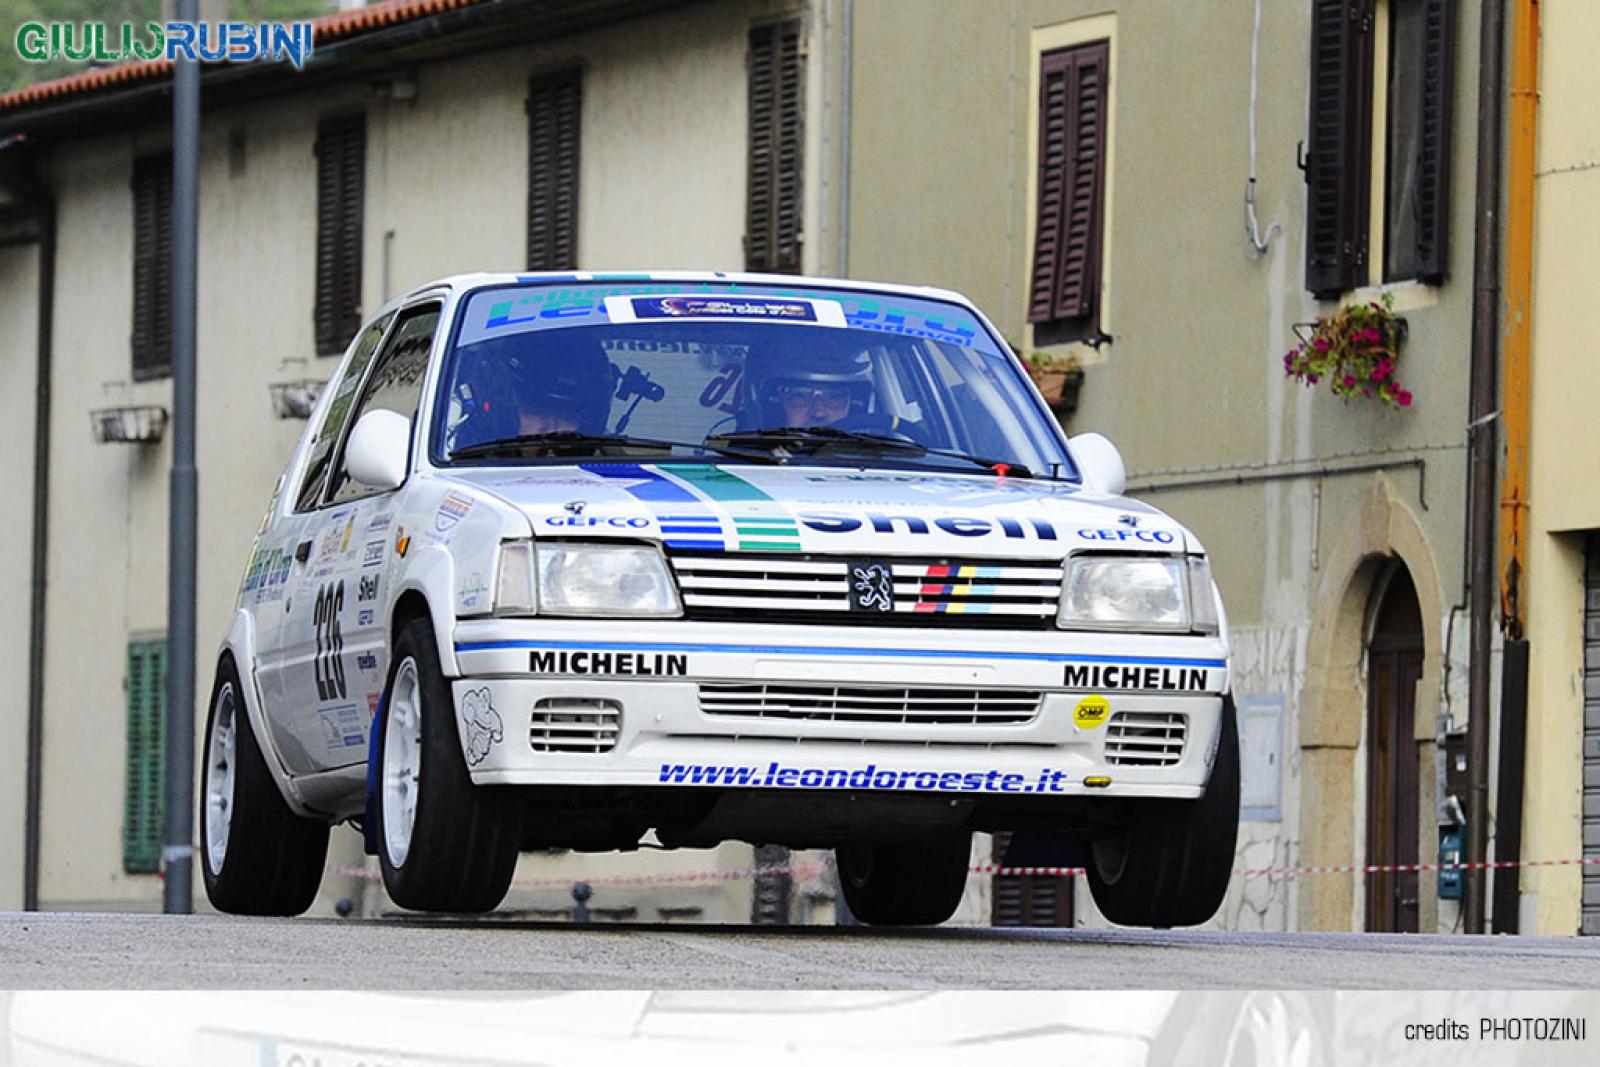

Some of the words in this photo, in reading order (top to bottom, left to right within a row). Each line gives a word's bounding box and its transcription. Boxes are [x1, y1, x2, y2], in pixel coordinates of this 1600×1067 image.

[545, 516, 650, 529] GEFCO
[800, 510, 1057, 541] Shell
[1078, 526, 1175, 544] GEFCO
[314, 579, 347, 702] 226
[529, 650, 688, 676] MICHELIN
[1063, 665, 1208, 690] MICHELIN
[659, 760, 1067, 793] www.leondoroeste.it
